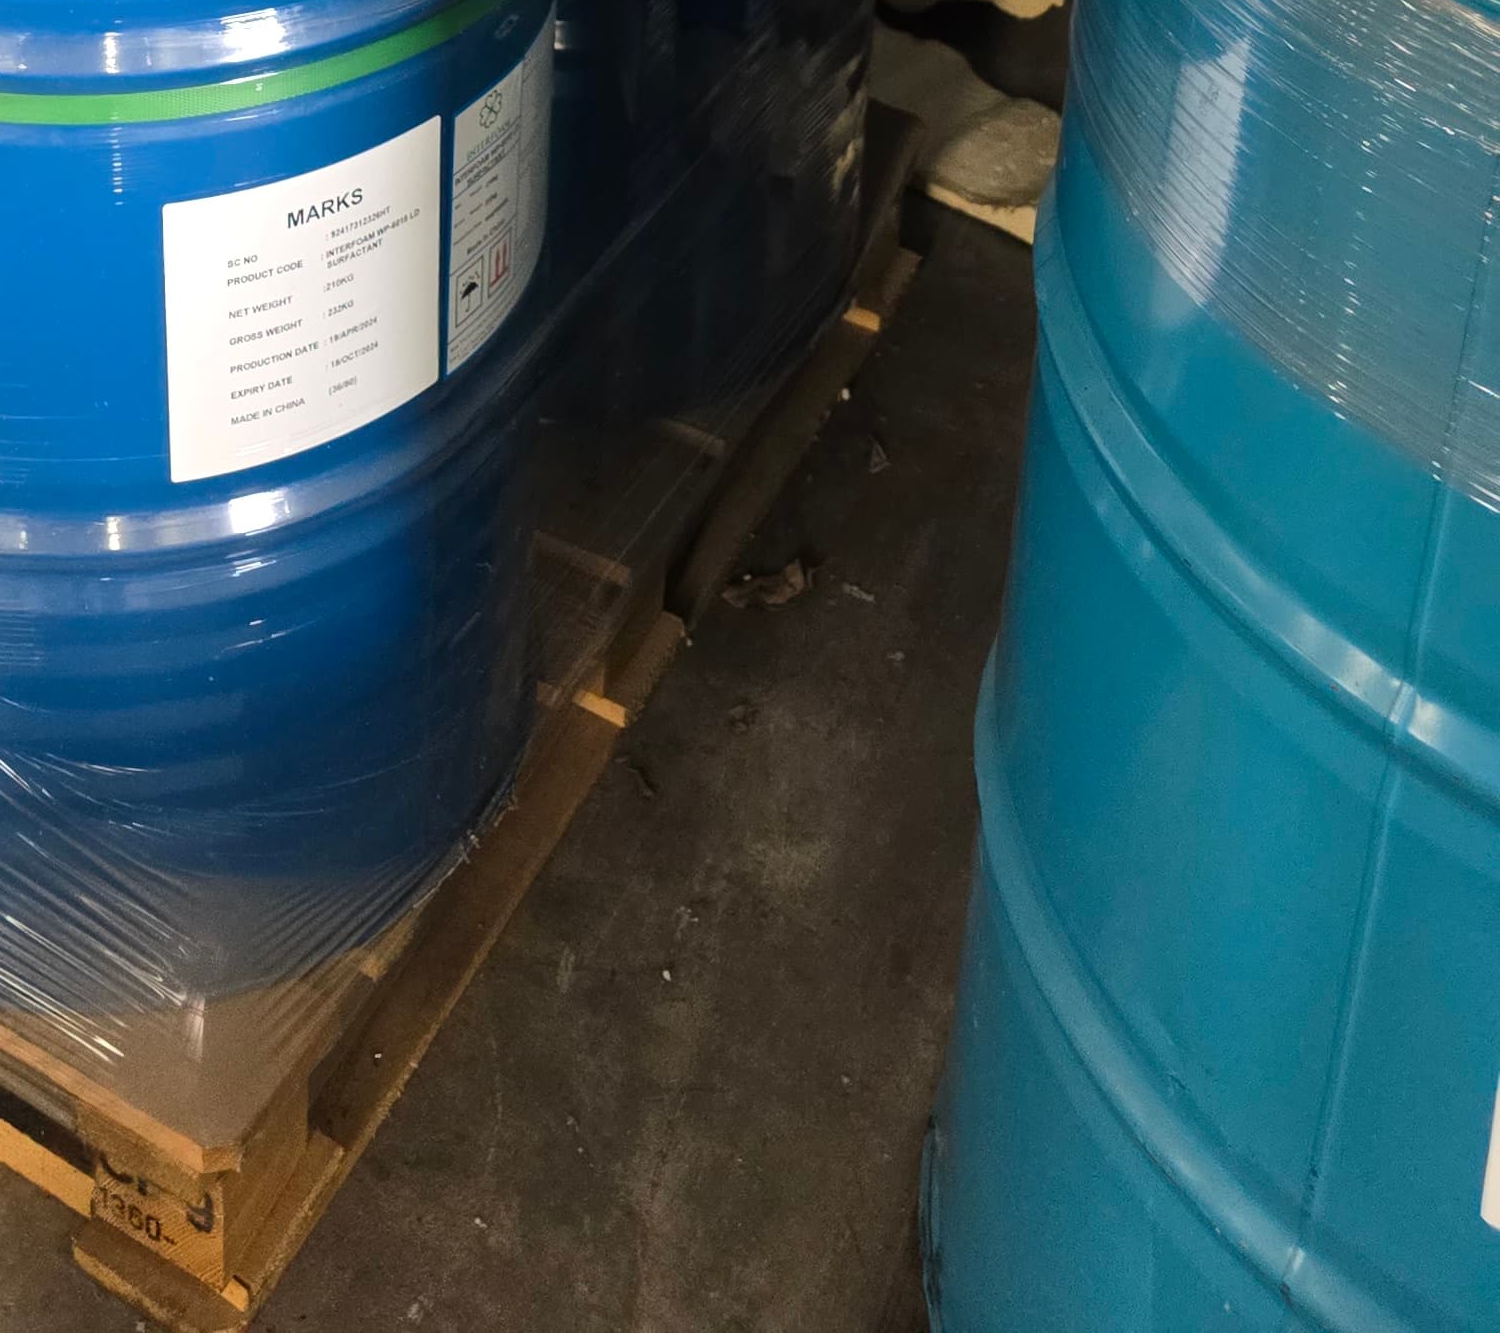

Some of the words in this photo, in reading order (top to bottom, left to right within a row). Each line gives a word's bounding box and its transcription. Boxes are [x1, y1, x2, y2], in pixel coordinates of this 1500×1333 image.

[286, 187, 364, 229] MARKS
[227, 267, 274, 287] PRODUCT
[276, 259, 304, 276] CODE
[325, 231, 376, 259] INTERFOAM
[227, 257, 241, 269] SC
[243, 253, 259, 265] NO
[326, 238, 384, 269] SURFACTANT
[228, 306, 250, 320] NET
[252, 295, 293, 315] WEIGHT
[229, 330, 263, 346] GROSS
[265, 318, 304, 337] WEIGHT
[229, 350, 294, 374] PRODUCTION
[294, 340, 320, 357] DATE
[230, 383, 267, 400] EXPIRY
[267, 375, 294, 391] DATE
[230, 411, 261, 426] MADE
[262, 406, 273, 418] IN
[274, 396, 307, 415] CHINA
